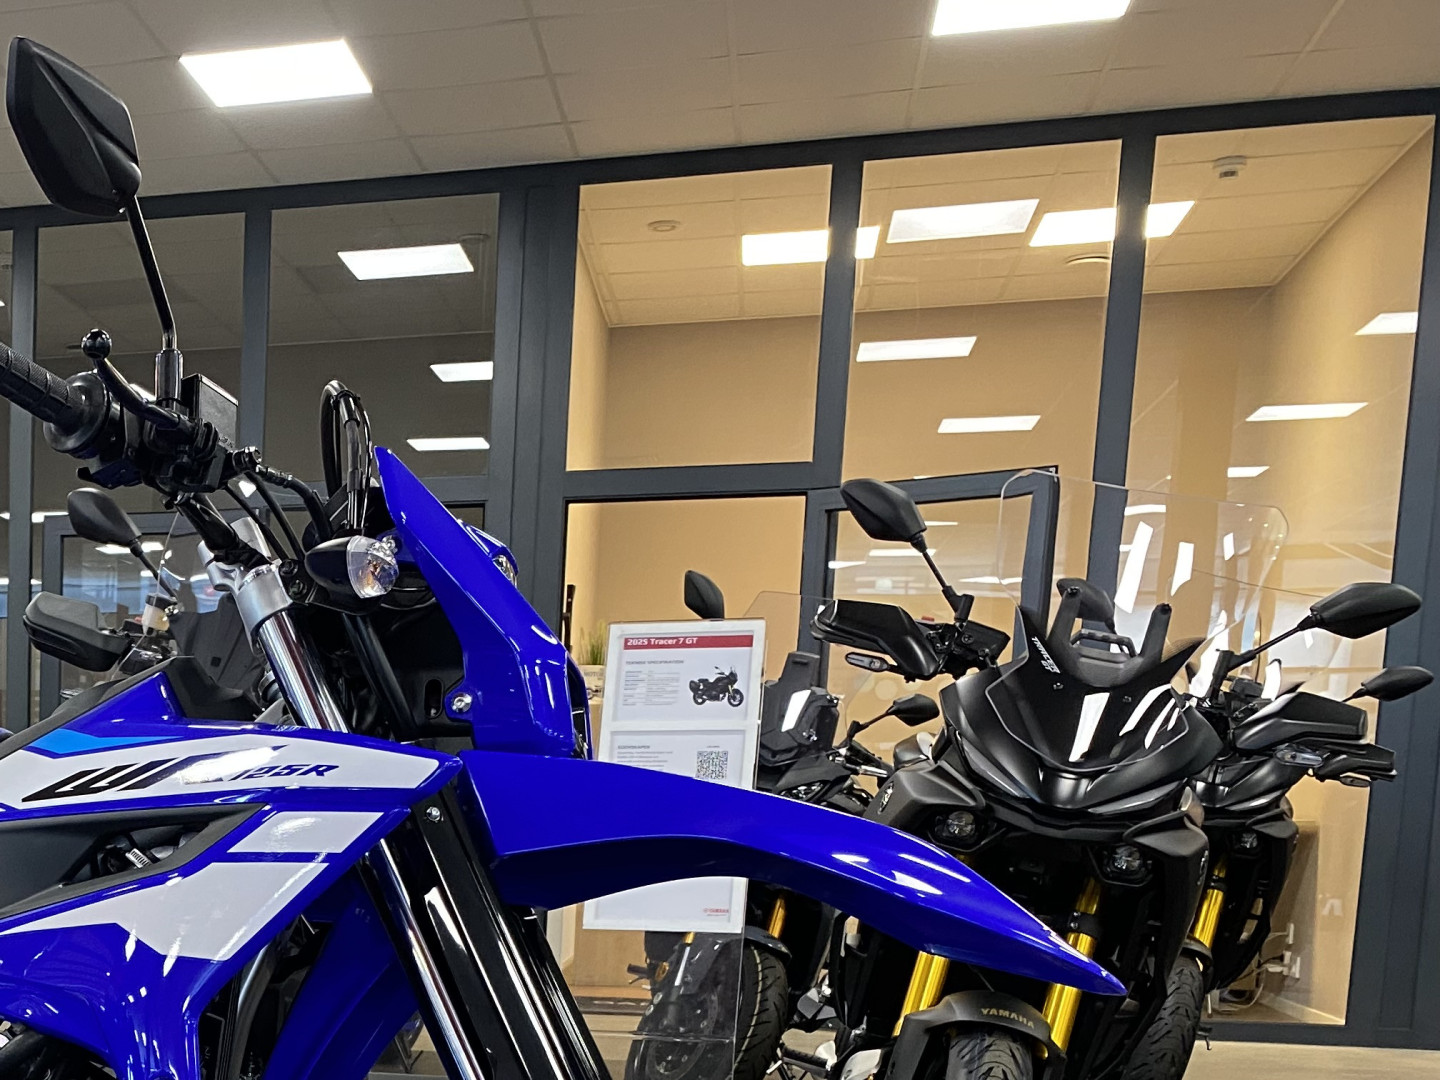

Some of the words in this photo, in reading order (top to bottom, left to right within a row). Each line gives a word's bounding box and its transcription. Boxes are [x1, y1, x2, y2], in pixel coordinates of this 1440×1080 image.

[627, 638, 649, 646] 2025
[649, 637, 678, 645] Tracer
[228, 764, 340, 781] 125R
[981, 1007, 1034, 1029] YAMAHA
